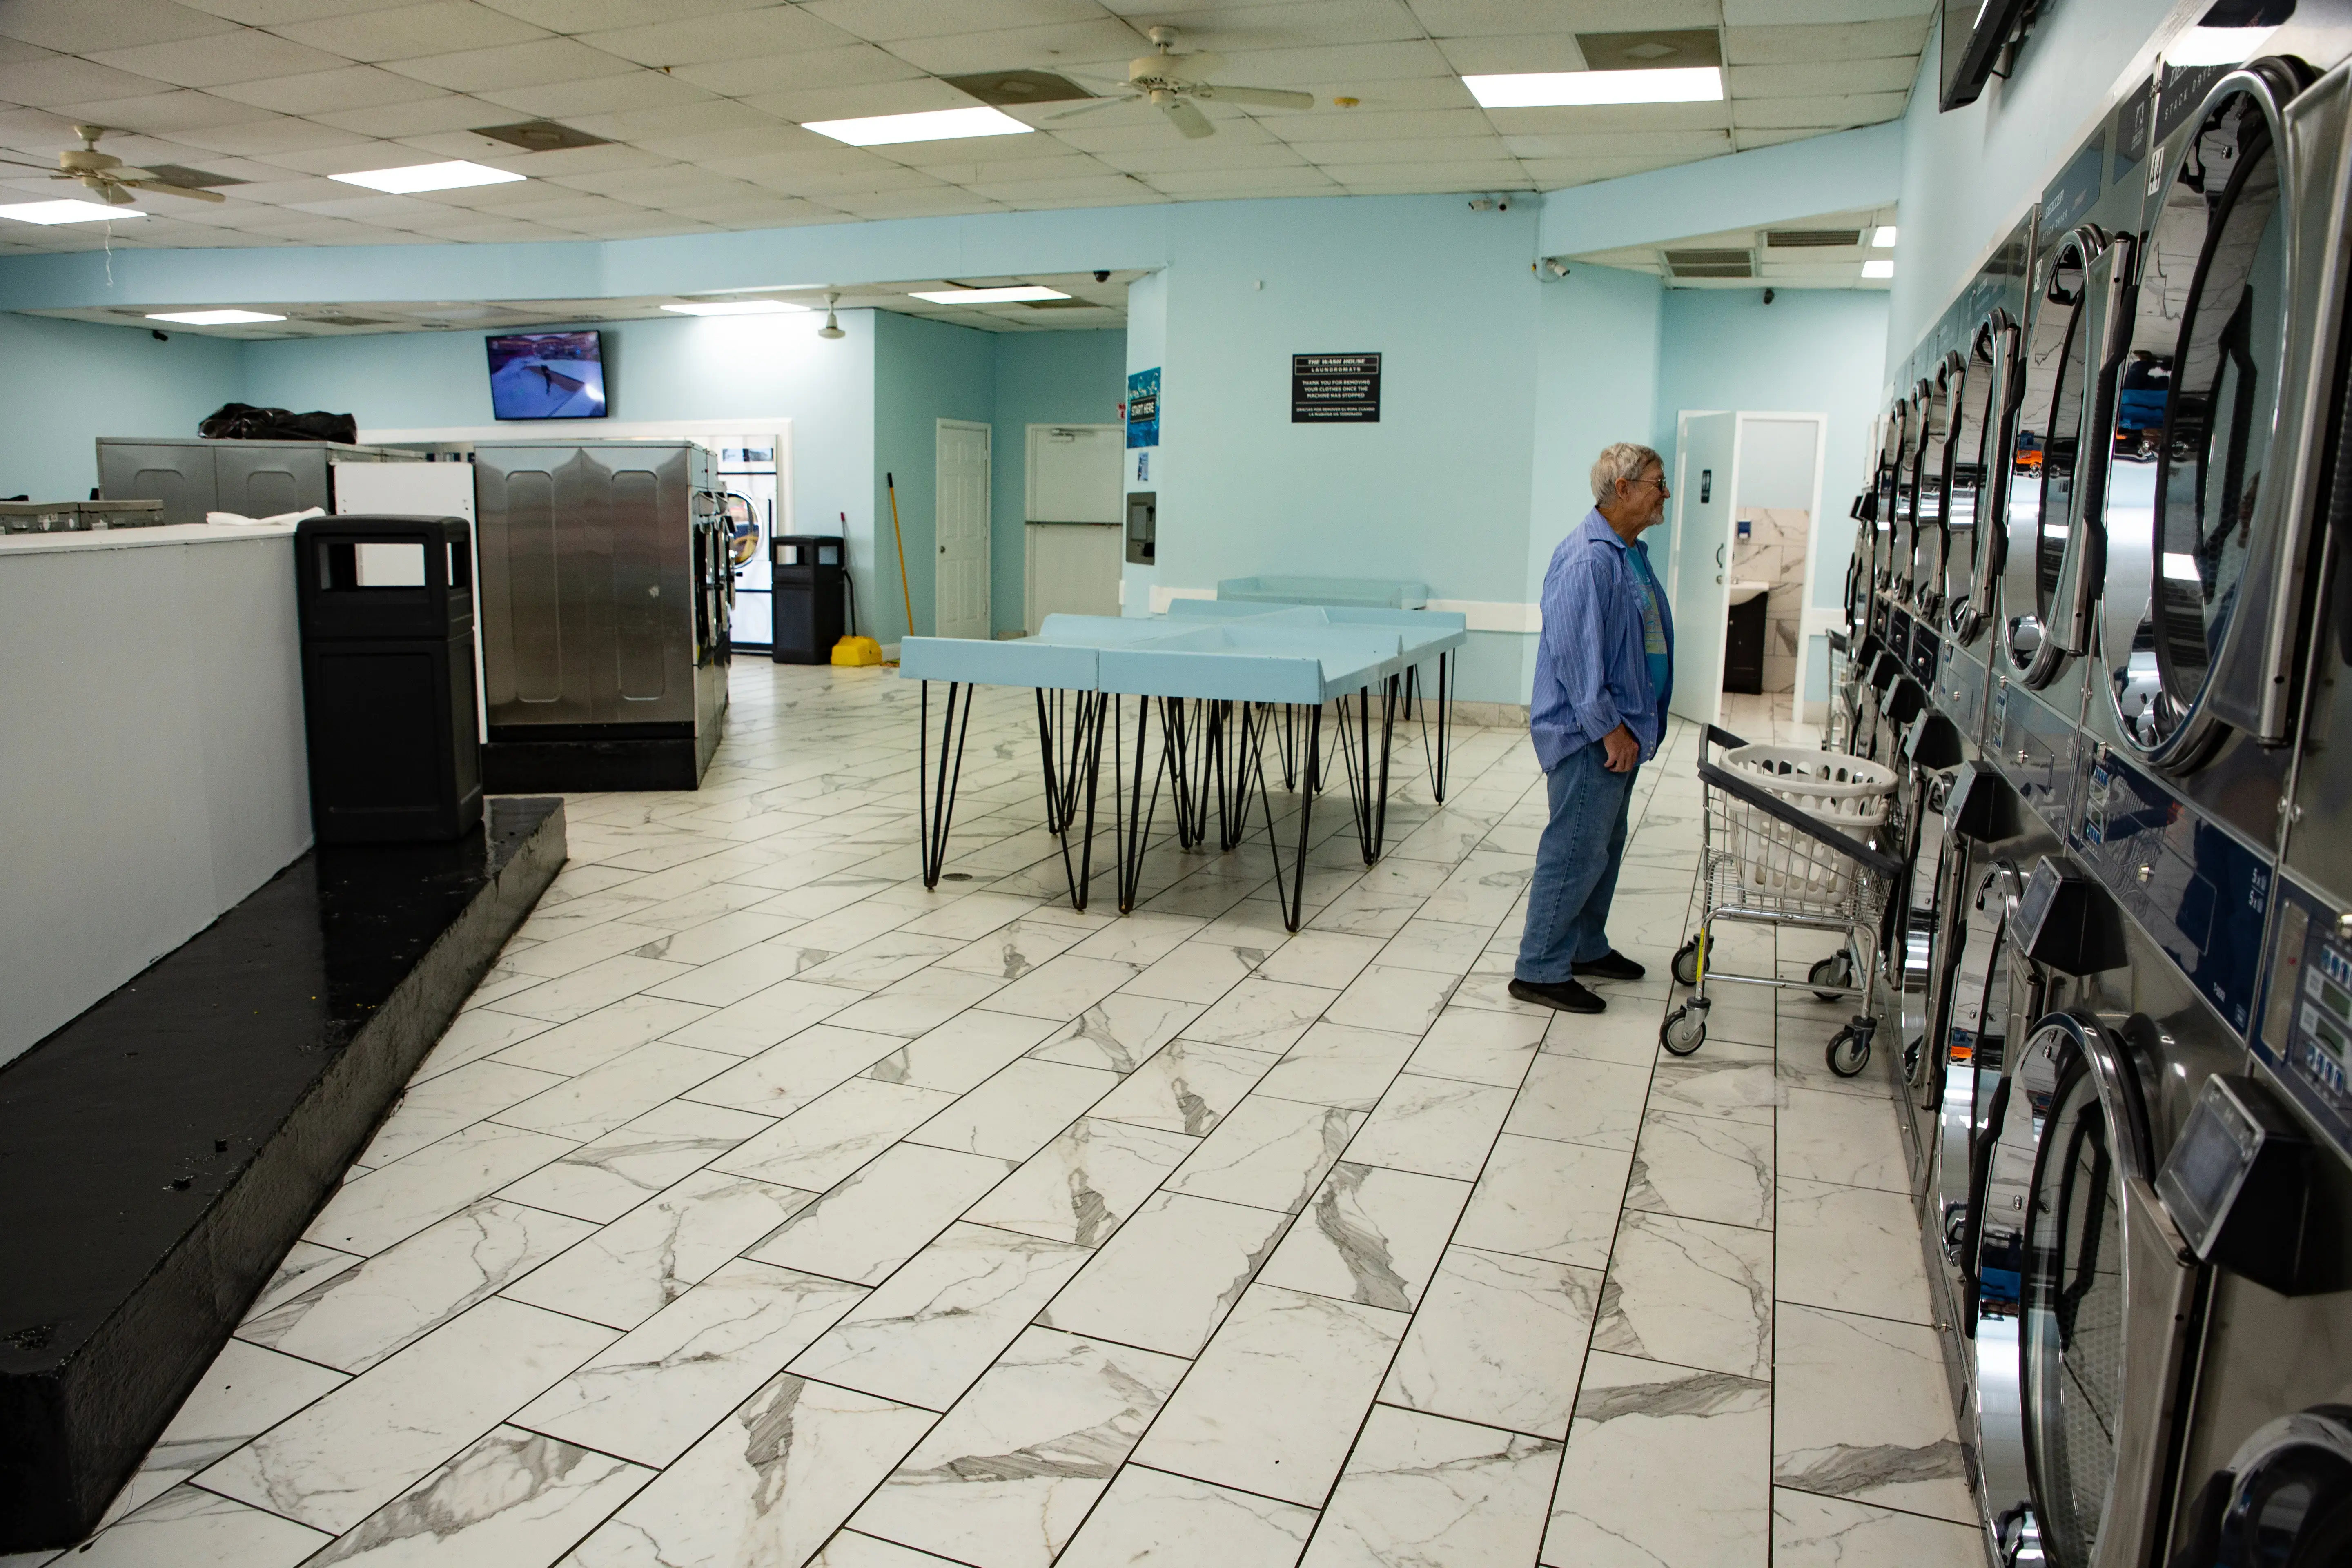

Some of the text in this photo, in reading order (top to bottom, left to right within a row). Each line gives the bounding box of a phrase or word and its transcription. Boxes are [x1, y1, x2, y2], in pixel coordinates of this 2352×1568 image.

[2165, 87, 2188, 120] STACK
[2150, 149, 2162, 192] 44
[2044, 189, 2064, 220] DEXTER
[1131, 404, 1143, 416] START
[1143, 401, 1154, 414] HERE
